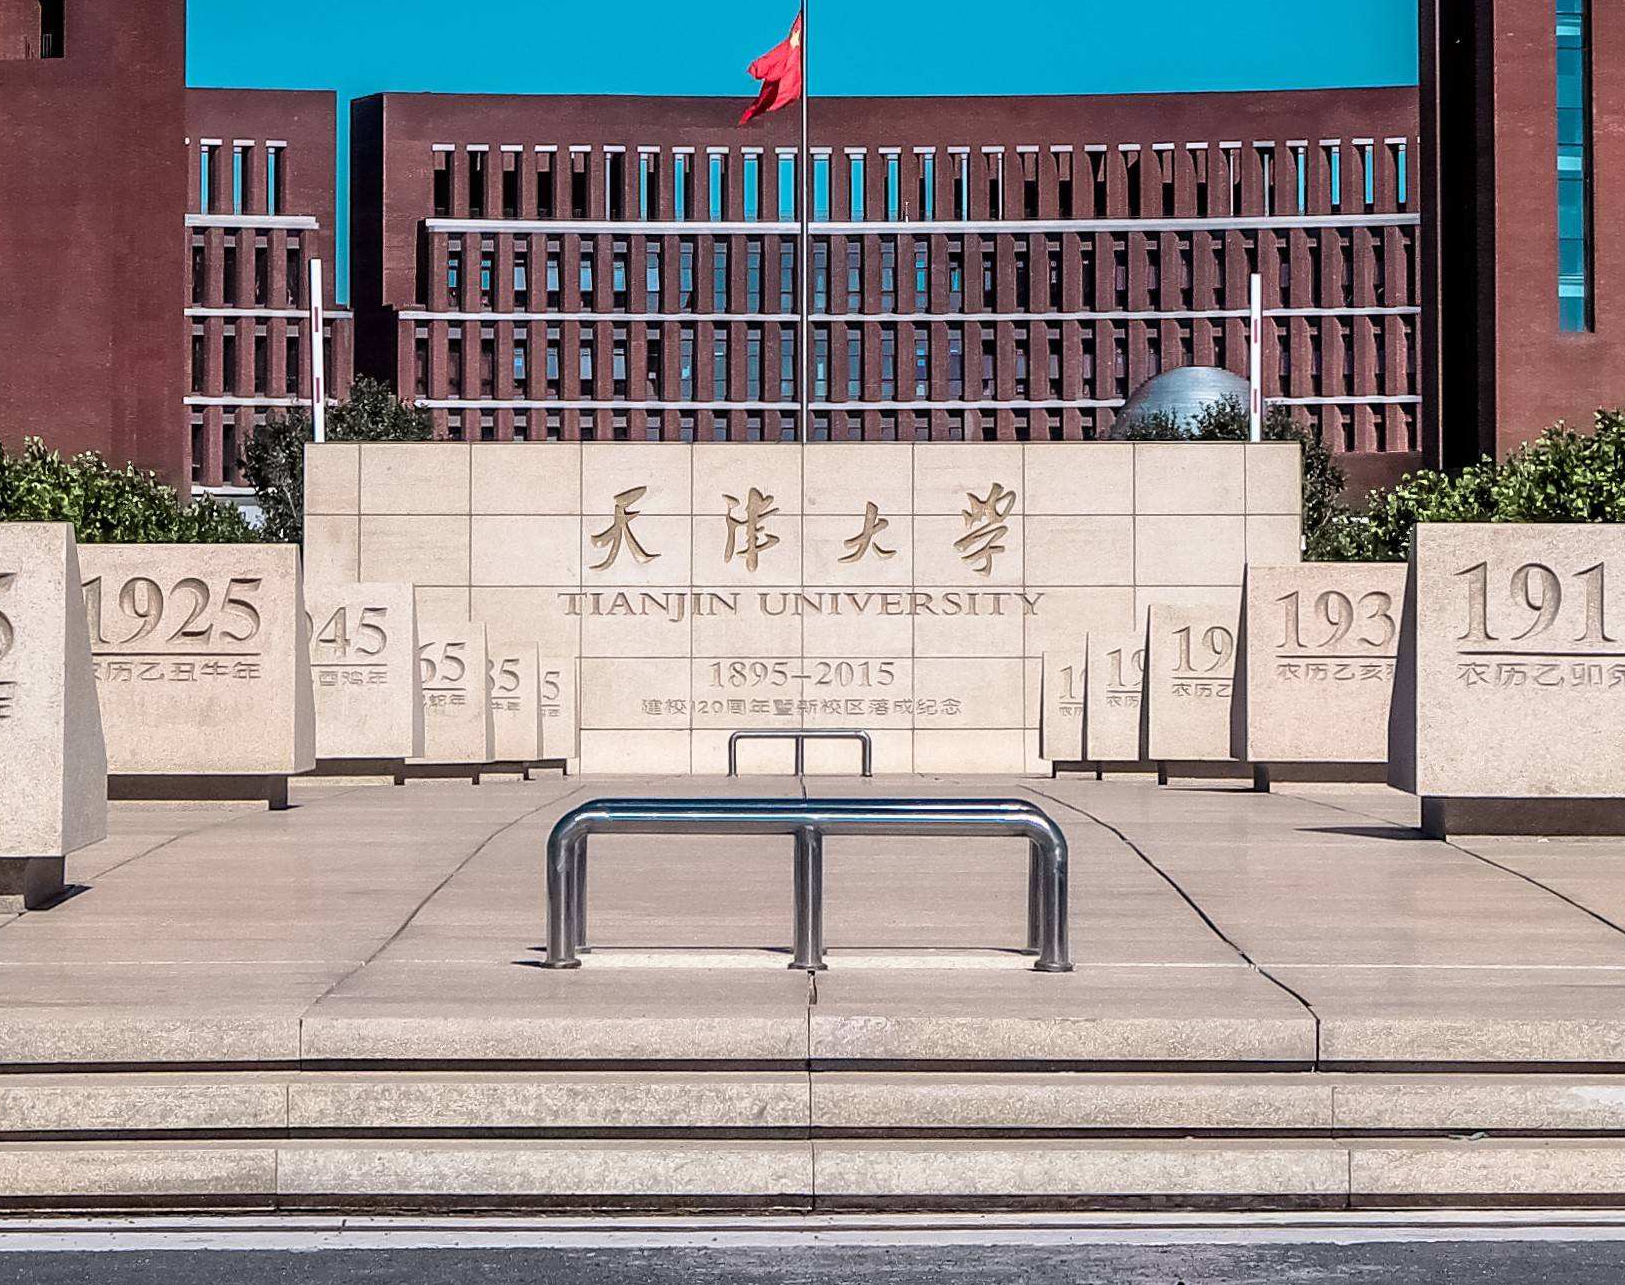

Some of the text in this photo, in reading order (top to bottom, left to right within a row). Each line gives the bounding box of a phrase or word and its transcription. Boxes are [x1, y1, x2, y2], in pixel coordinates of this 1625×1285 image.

[588, 482, 1017, 577] 天津大学
[81, 575, 263, 645] 1925
[305, 606, 388, 657] 45
[557, 591, 1046, 623] TIANJIN UNIVERSITY
